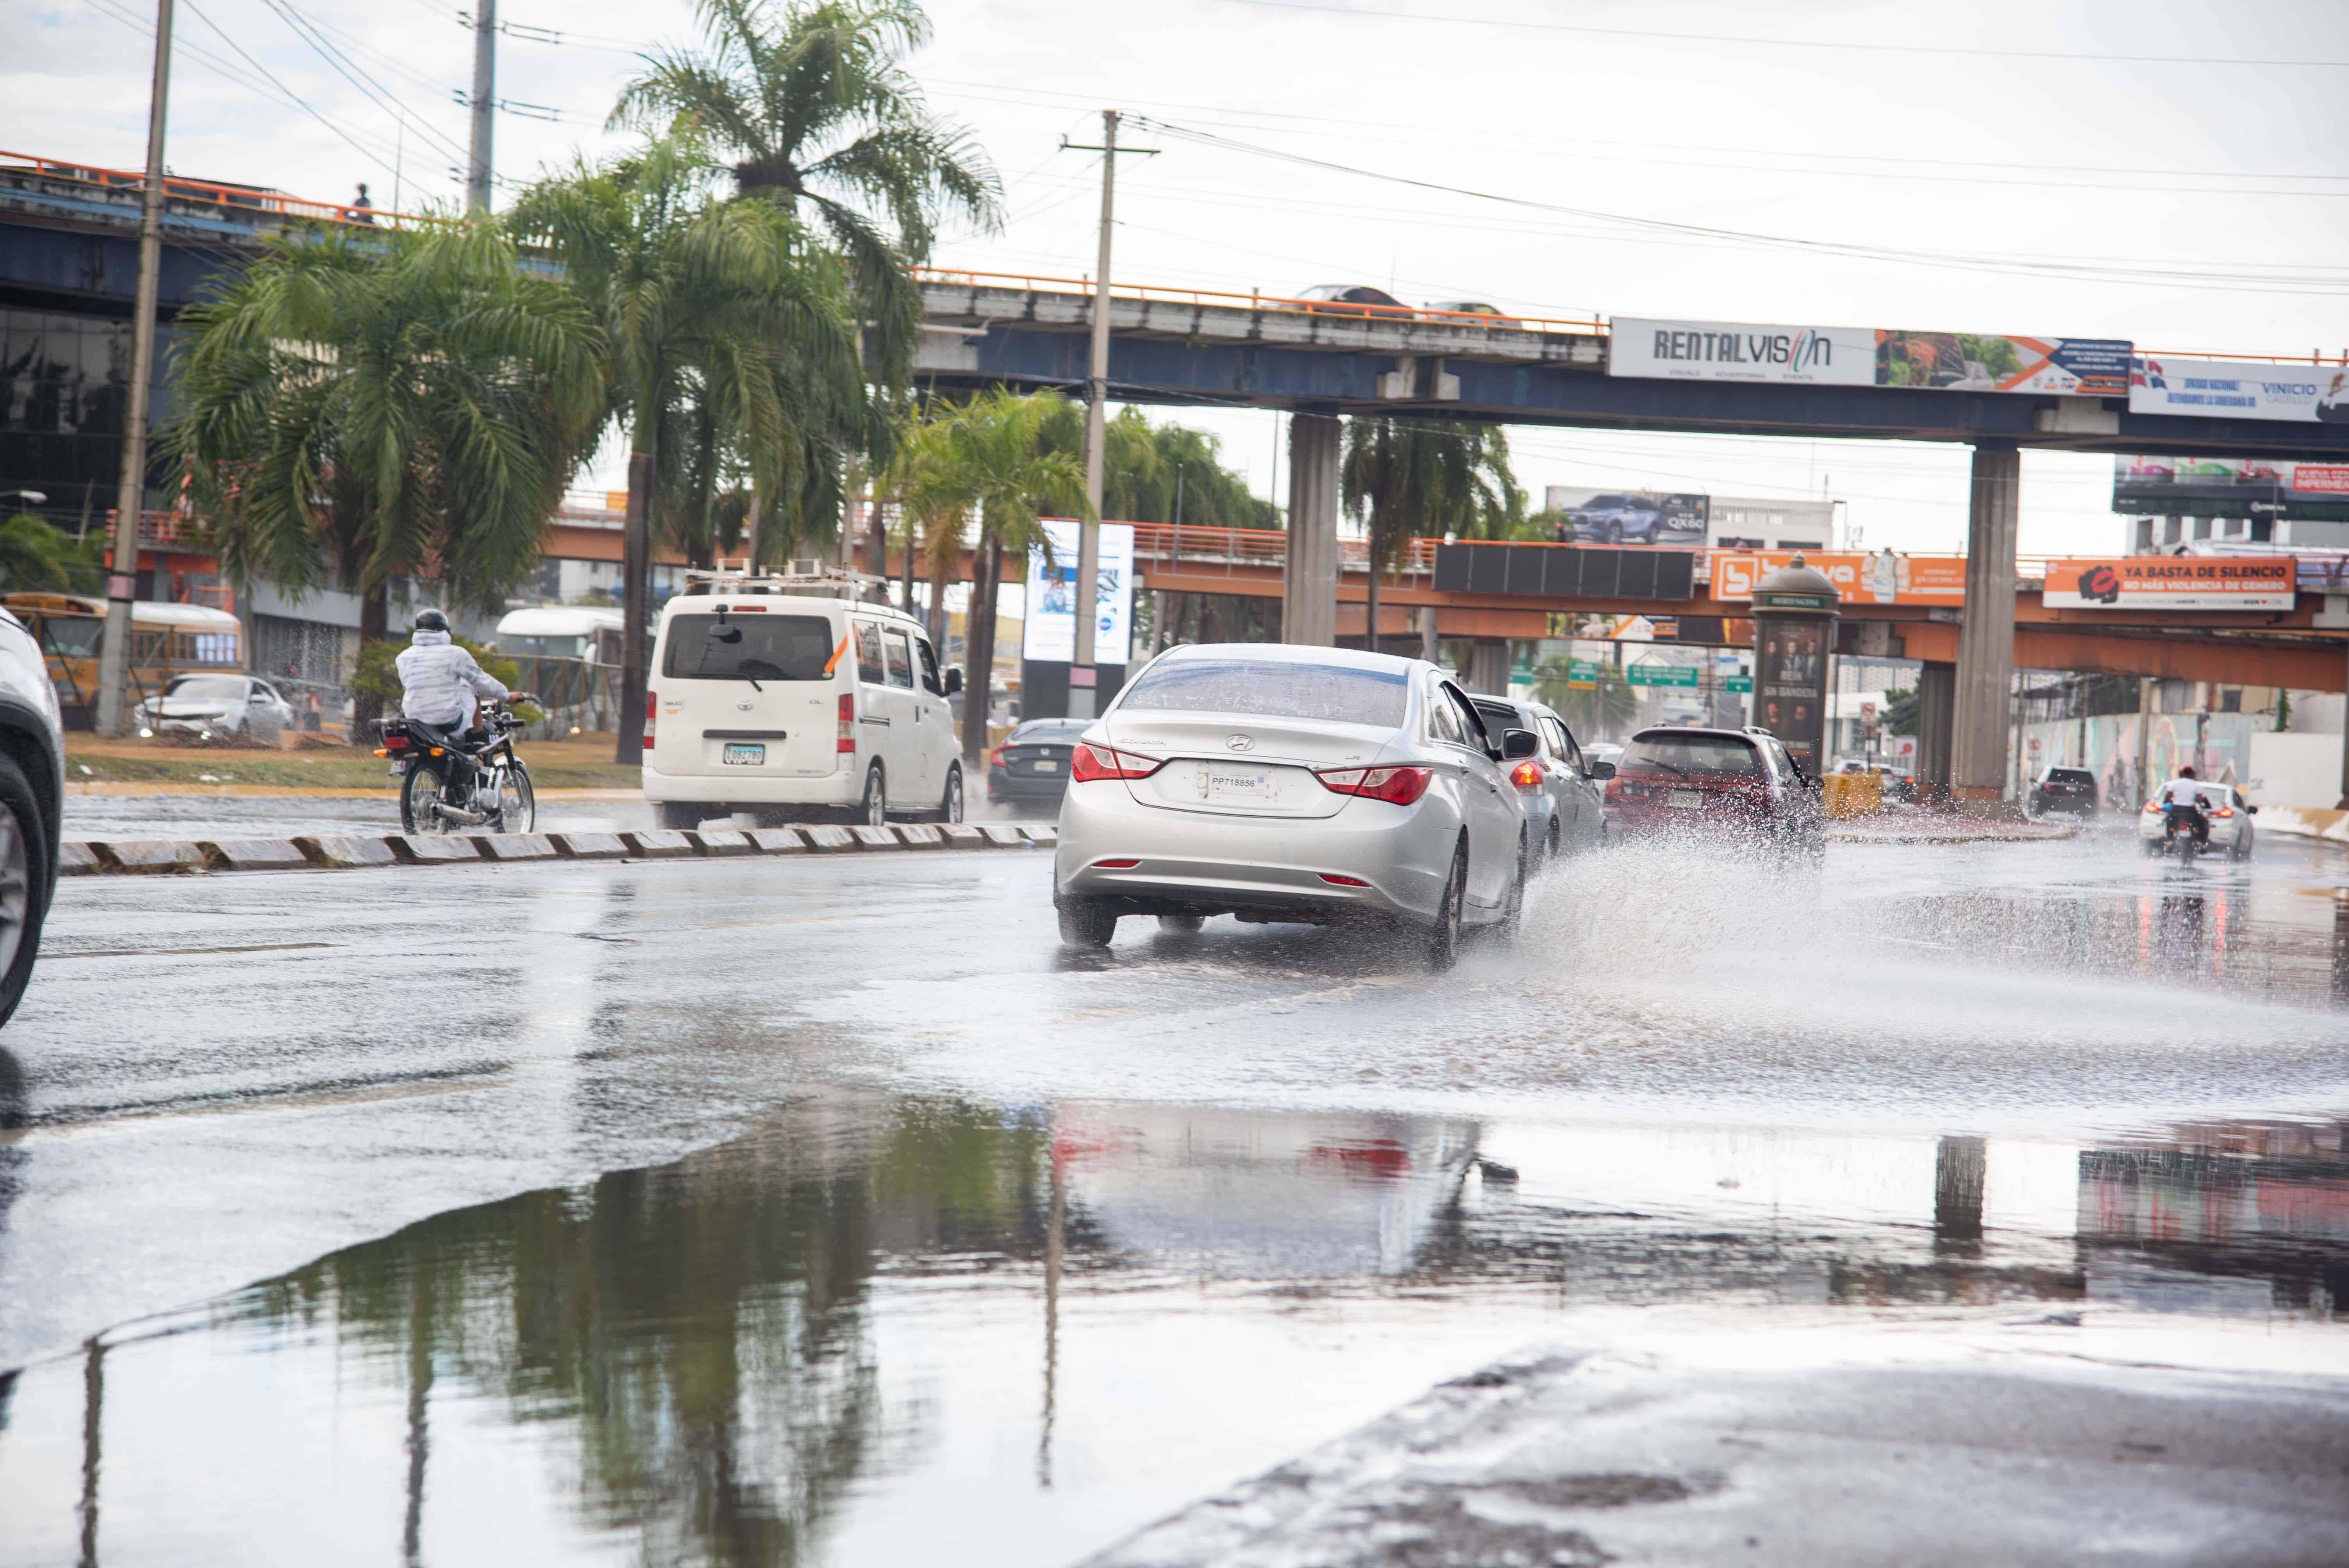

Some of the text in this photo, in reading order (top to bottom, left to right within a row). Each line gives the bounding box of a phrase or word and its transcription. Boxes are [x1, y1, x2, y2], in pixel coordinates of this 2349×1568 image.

[2262, 383, 2317, 395] VINICIO
[2267, 395, 2312, 404] CASTILLO
[1668, 517, 1704, 529] QX60
[2125, 566, 2287, 578] YA BASTA DE SILENCIO
[2123, 581, 2140, 590] NO
[2167, 581, 2222, 591] VIOLENCIA
[2224, 581, 2239, 590] DE
[1796, 597, 1820, 607] NACIONAL
[1763, 686, 1818, 698] SIN BANDERA
[1118, 738, 1168, 746] SONATA
[1212, 777, 1255, 788] PP718856
